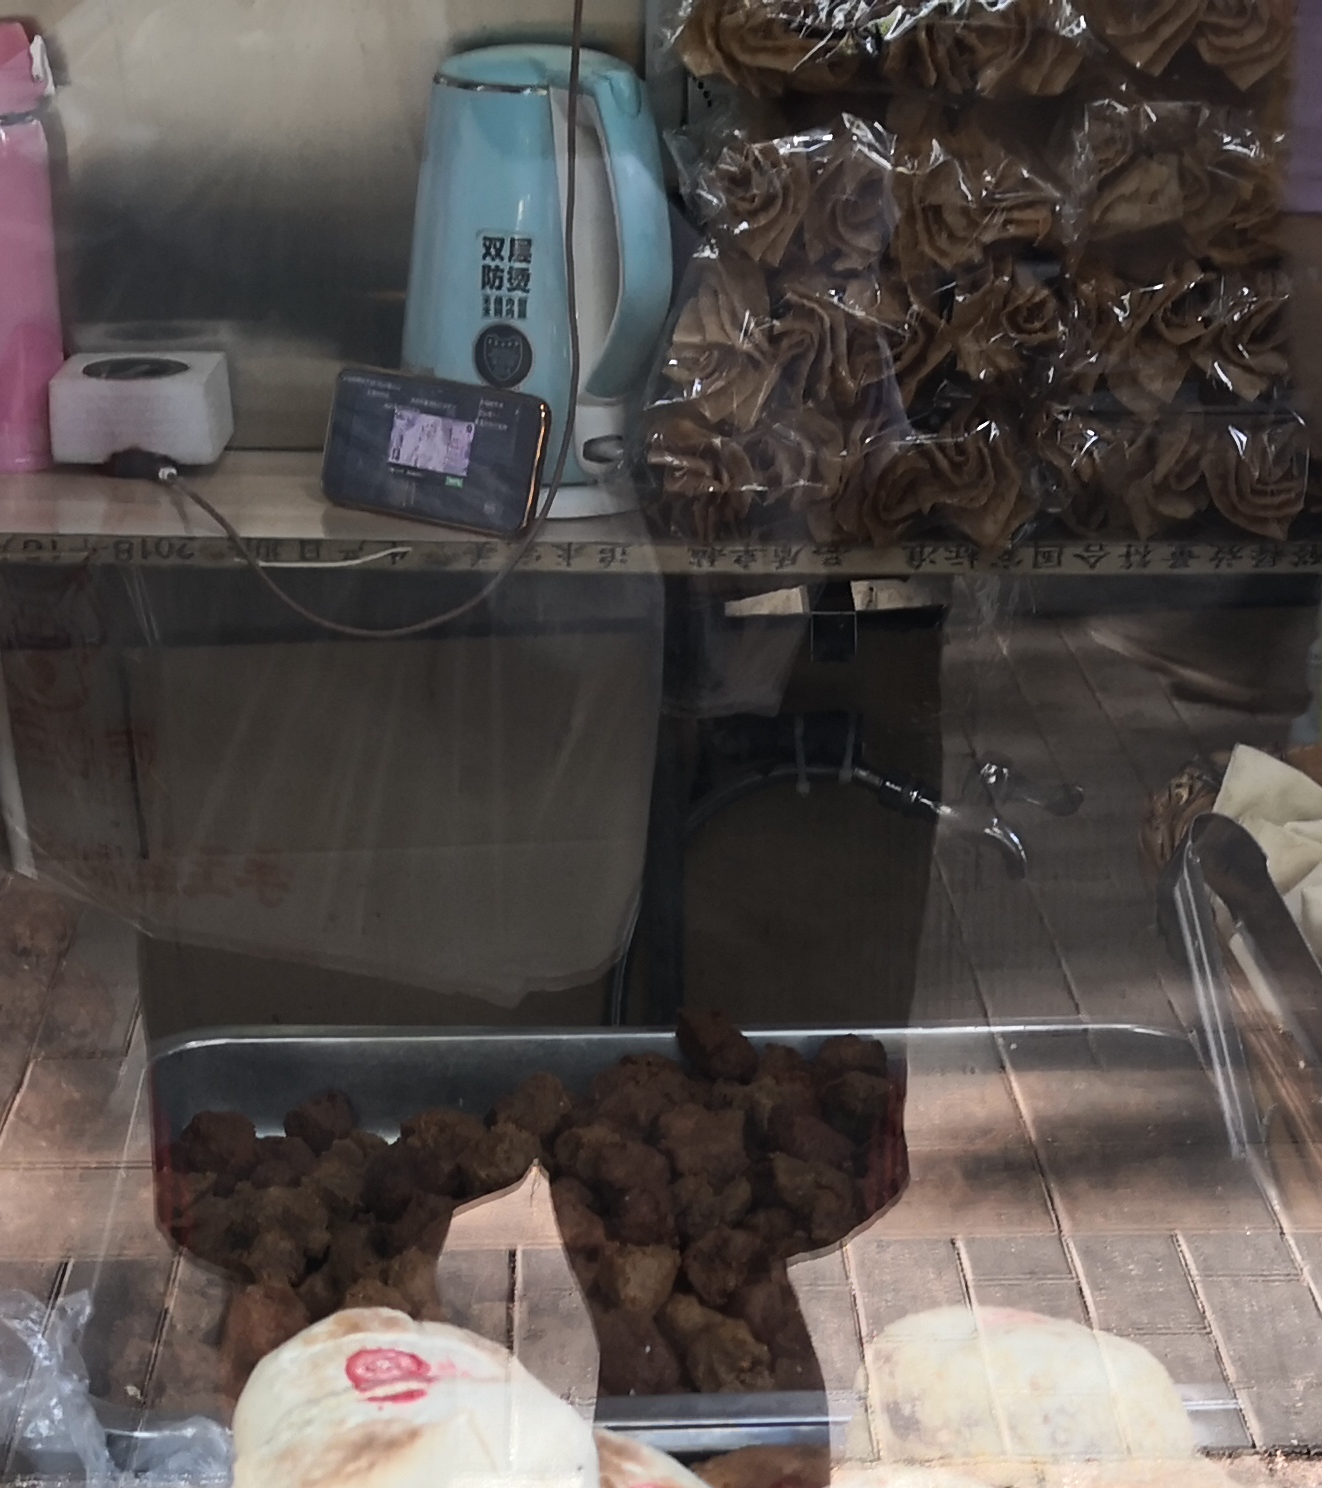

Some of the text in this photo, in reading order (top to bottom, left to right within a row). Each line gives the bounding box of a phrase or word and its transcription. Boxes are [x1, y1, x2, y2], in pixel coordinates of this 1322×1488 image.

[481, 236, 533, 264] 双层
[480, 264, 532, 294] 防烫
[686, 544, 851, 571] 品质卓越
